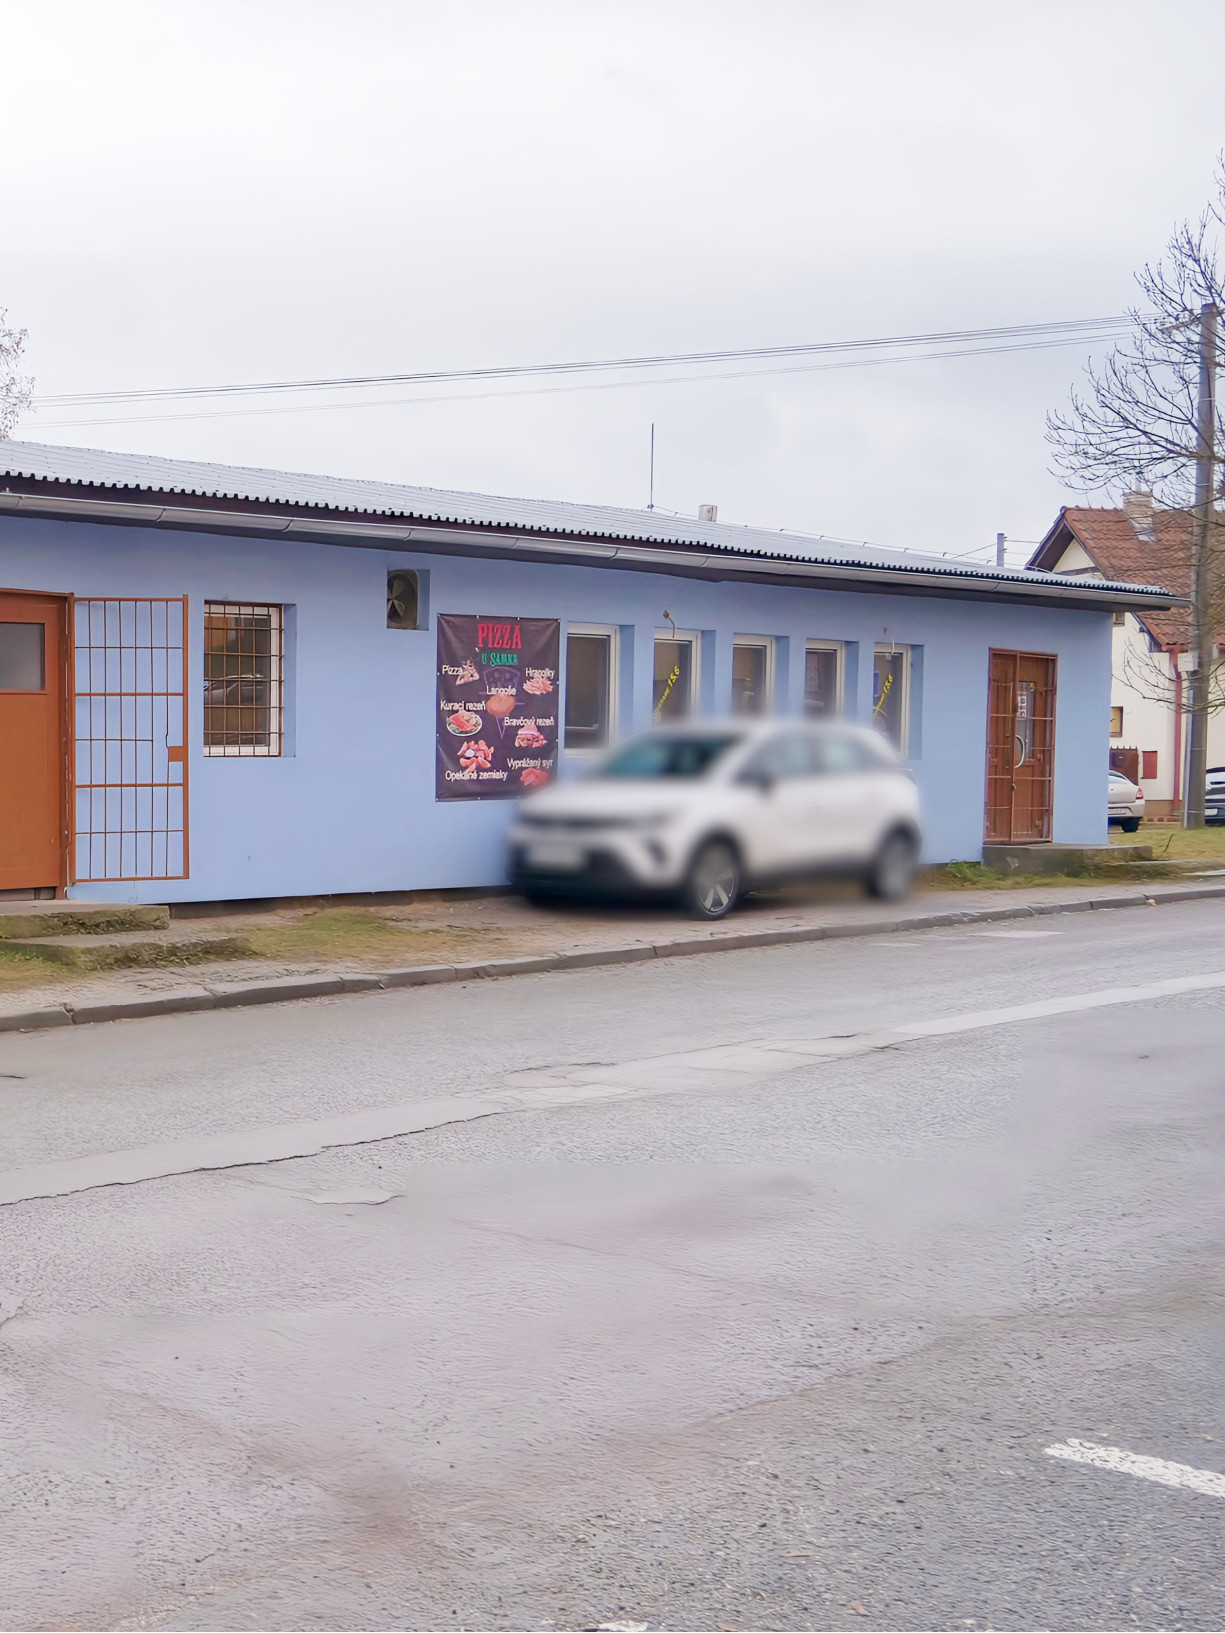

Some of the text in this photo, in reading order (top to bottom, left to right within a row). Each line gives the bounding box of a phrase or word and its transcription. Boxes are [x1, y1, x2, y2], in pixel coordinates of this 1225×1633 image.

[478, 624, 522, 648] PIZZA
[481, 653, 488, 665] U
[442, 665, 464, 675] Pizza
